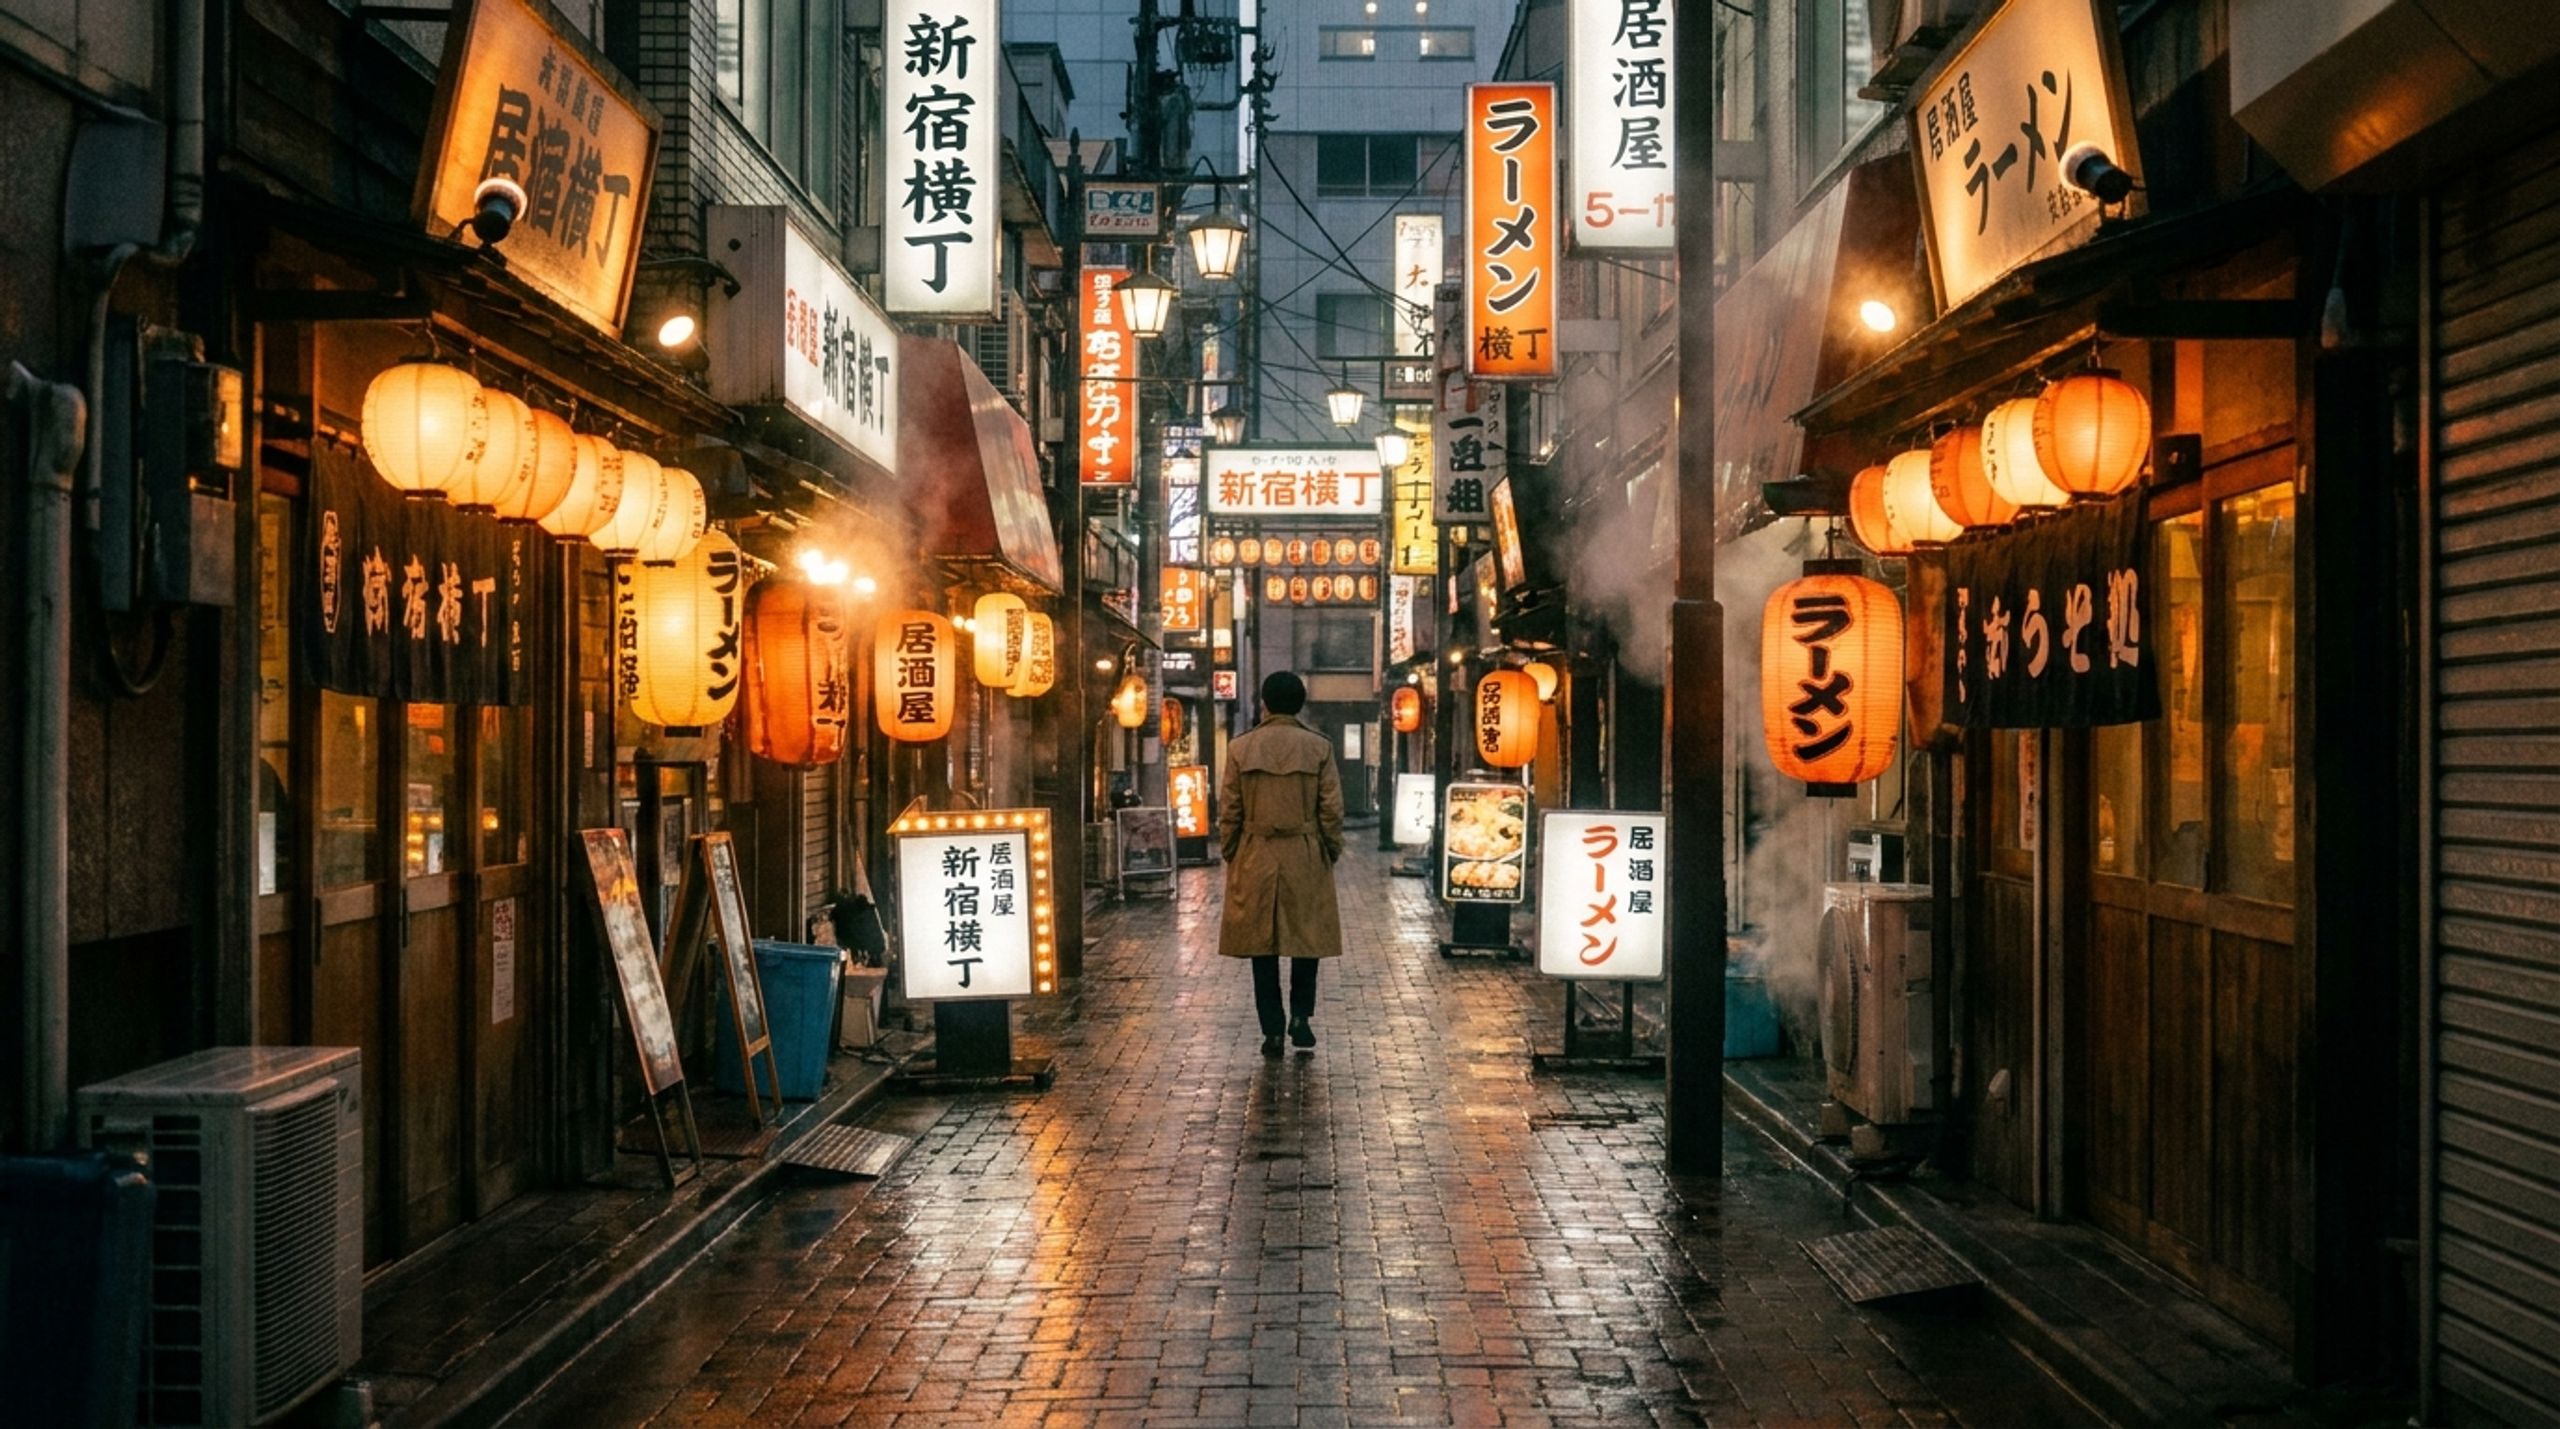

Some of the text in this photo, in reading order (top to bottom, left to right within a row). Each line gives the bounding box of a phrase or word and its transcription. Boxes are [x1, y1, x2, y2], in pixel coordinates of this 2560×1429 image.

[903, 12, 977, 294] 新宿横丁
[1610, 0, 1668, 171] 居酒屋
[1963, 65, 2073, 237] ラーメン
[1484, 98, 1543, 313] ラーメン
[822, 294, 890, 436] 新宿横丁
[1479, 325, 1548, 361] 横丁
[1218, 469, 1380, 507] 新宿横丁
[706, 550, 740, 701] ラーメン
[895, 620, 937, 725] 居酒屋
[1788, 594, 1854, 762] ラーメン
[941, 844, 984, 990] 新宿横丁
[1578, 824, 1619, 966] ラーメン
